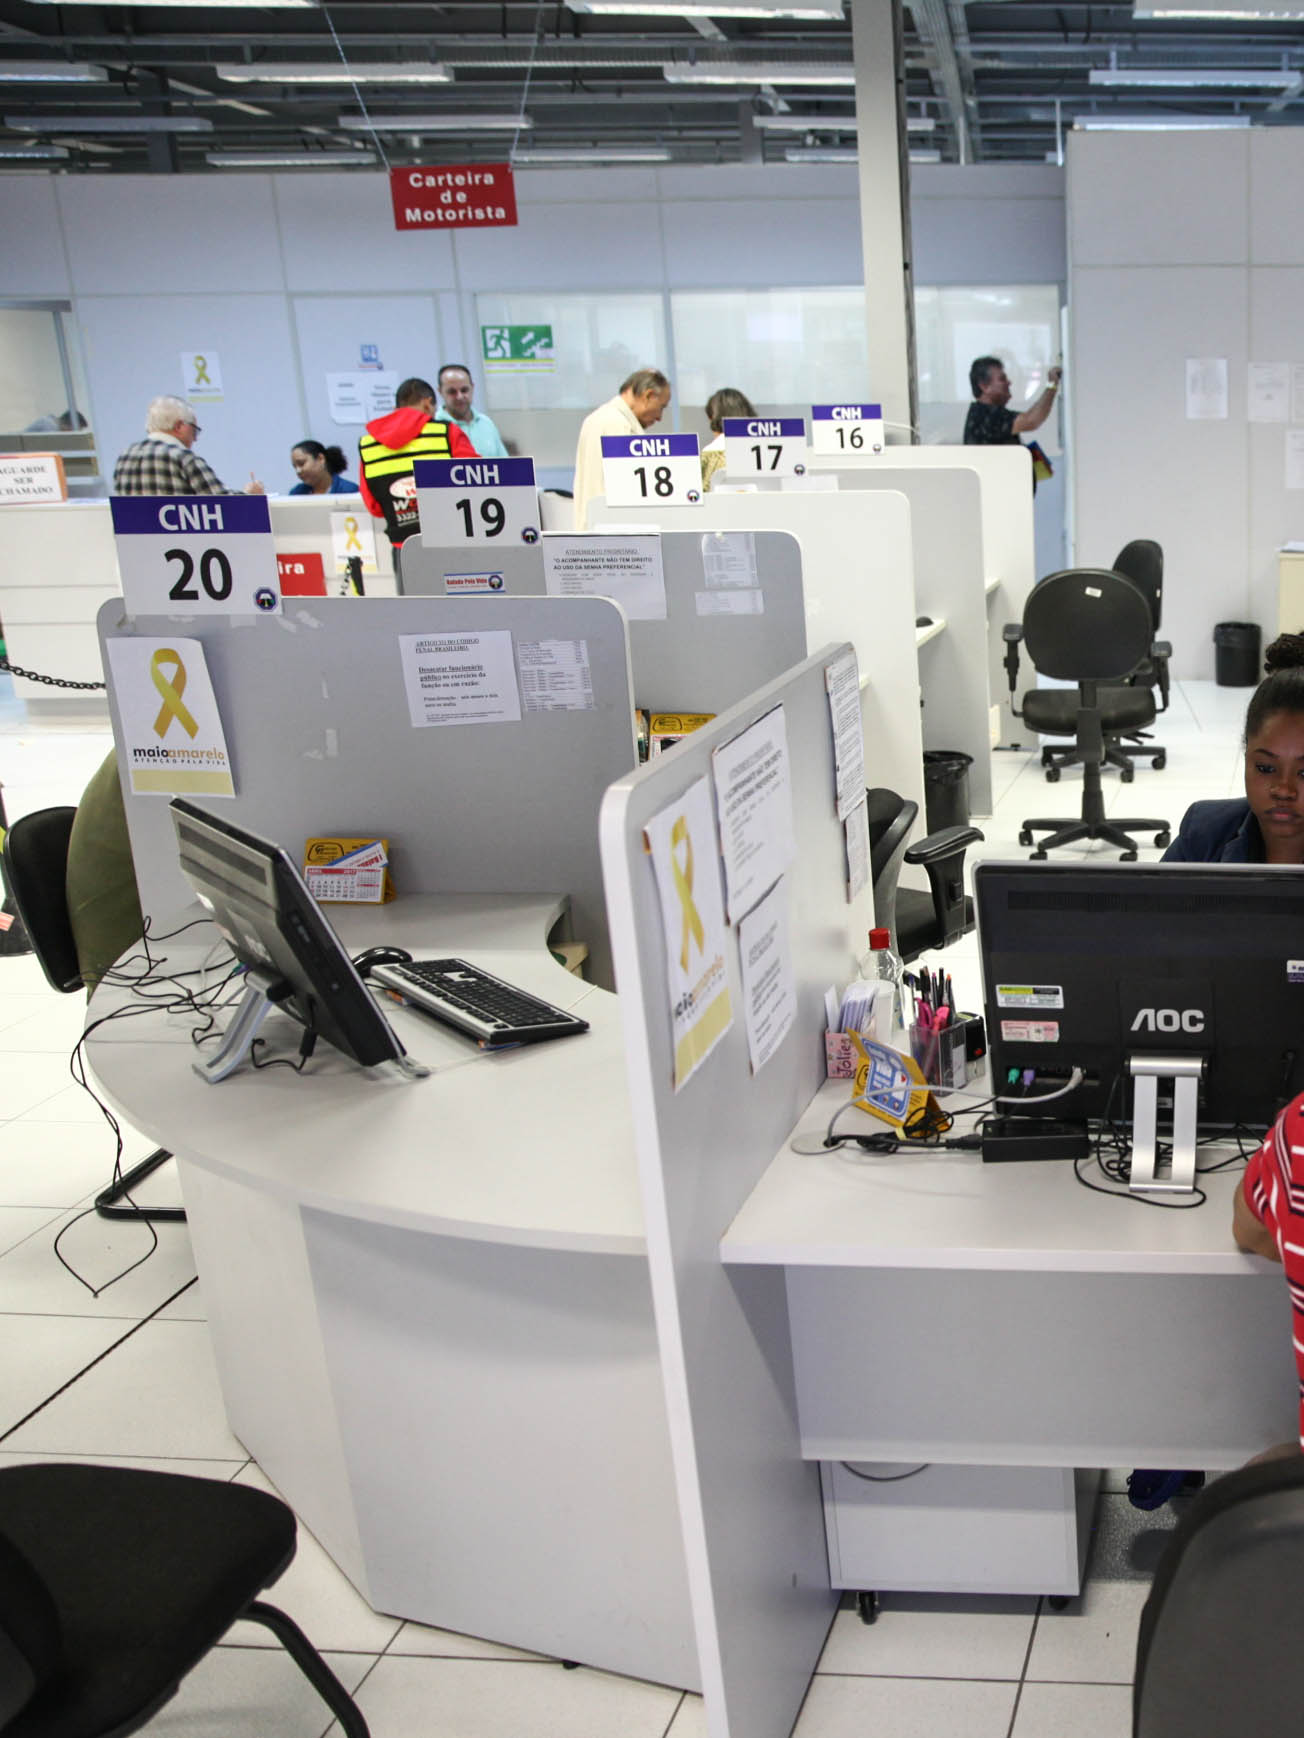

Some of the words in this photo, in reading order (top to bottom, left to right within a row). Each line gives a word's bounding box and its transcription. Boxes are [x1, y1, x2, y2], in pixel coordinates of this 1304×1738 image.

[409, 171, 494, 188] Carteira
[440, 190, 467, 204] de
[405, 206, 506, 222] Motorista
[832, 407, 862, 420] CNH
[747, 422, 781, 436] CNH
[835, 427, 864, 449] 16
[629, 439, 670, 456] CNH
[751, 445, 783, 470] 17
[450, 464, 499, 486] CNH
[634, 466, 674, 497] 18
[158, 504, 224, 531] CNH
[456, 498, 506, 538] 19
[164, 548, 232, 601] 20
[134, 746, 224, 760] maioamarelo
[1130, 1008, 1205, 1032] AOC
